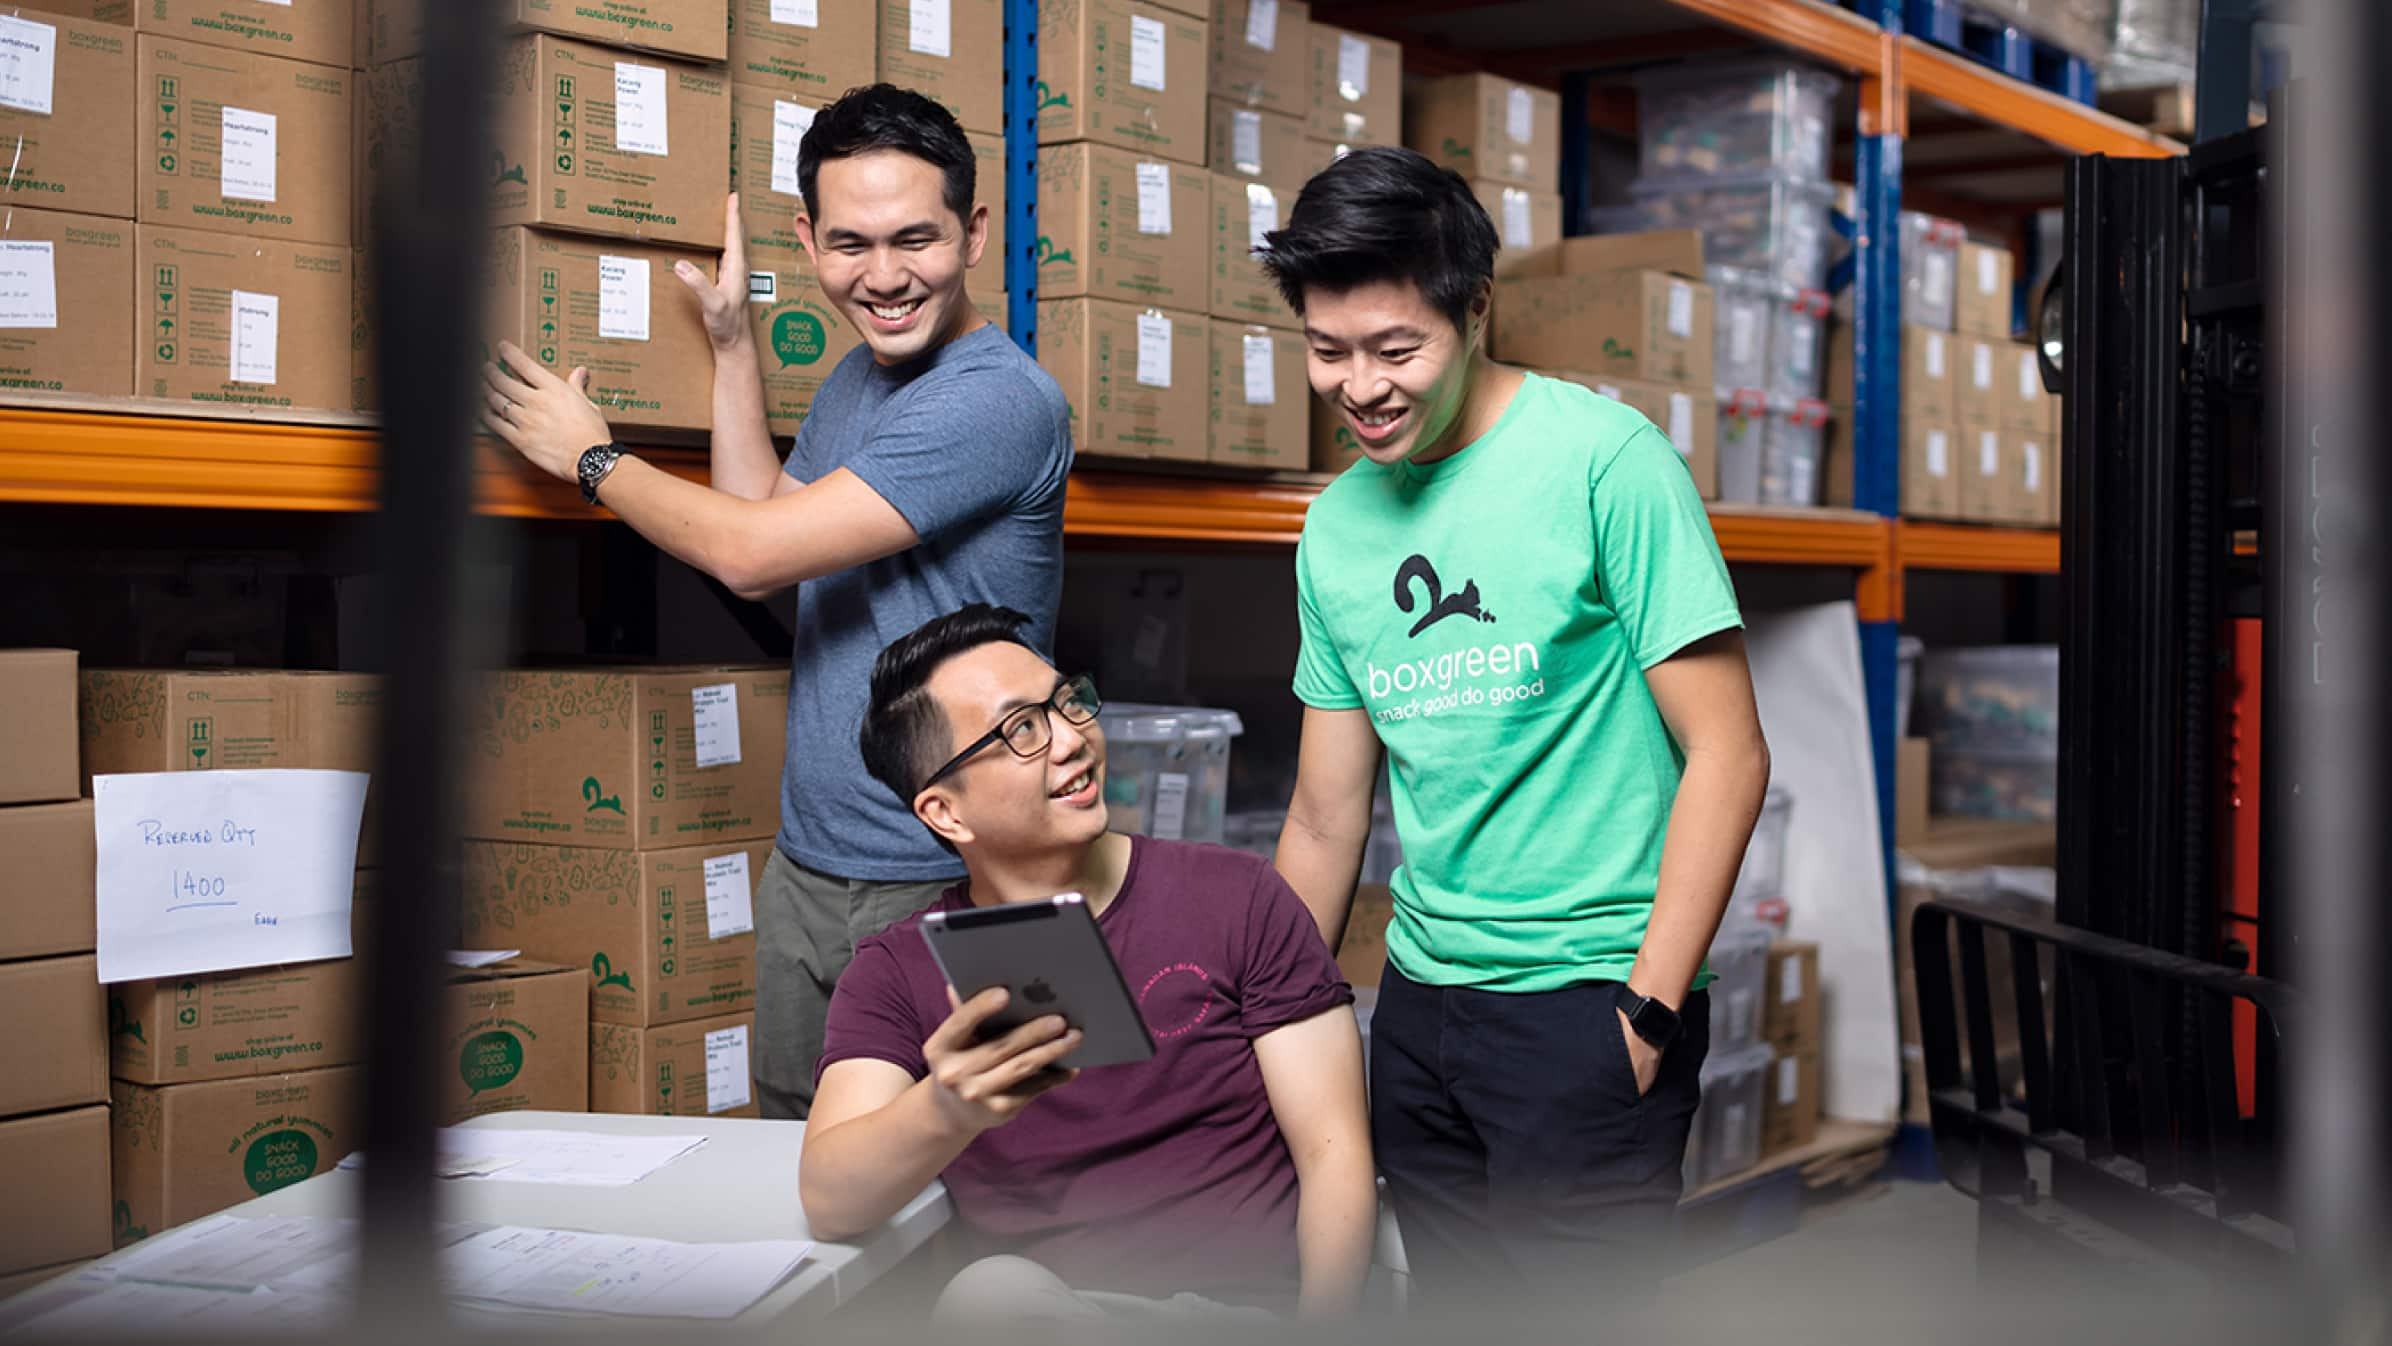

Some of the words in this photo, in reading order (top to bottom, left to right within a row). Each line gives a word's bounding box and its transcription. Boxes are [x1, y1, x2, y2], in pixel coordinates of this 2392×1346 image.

[576, 7, 672, 31] www.boxgreen.co
[192, 17, 293, 42] www.boxgreen.co
[193, 204, 293, 224] www.boxgreen.co
[587, 203, 677, 224] www.boxgreen.co
[787, 331, 812, 343] GOOD
[794, 343, 818, 356] GOOD
[192, 392, 292, 406] www.boxgreen.co
[1366, 641, 1540, 699] boxgreen
[1375, 699, 1421, 725] snack
[1422, 691, 1458, 718] good
[1461, 684, 1485, 705] do
[1488, 678, 1545, 706] good
[221, 818, 257, 847] QTY
[172, 869, 226, 899] 1400
[214, 1040, 323, 1063] www.boxgreen.co
[478, 1053, 505, 1065] GOOD
[487, 1063, 514, 1077] GOOD
[242, 1115, 285, 1142] natural
[287, 1116, 334, 1140] yummies
[264, 1141, 299, 1155] SNACK
[266, 1154, 297, 1168] GOOD
[256, 1169, 271, 1182] DO
[276, 1165, 306, 1179] GOOD
